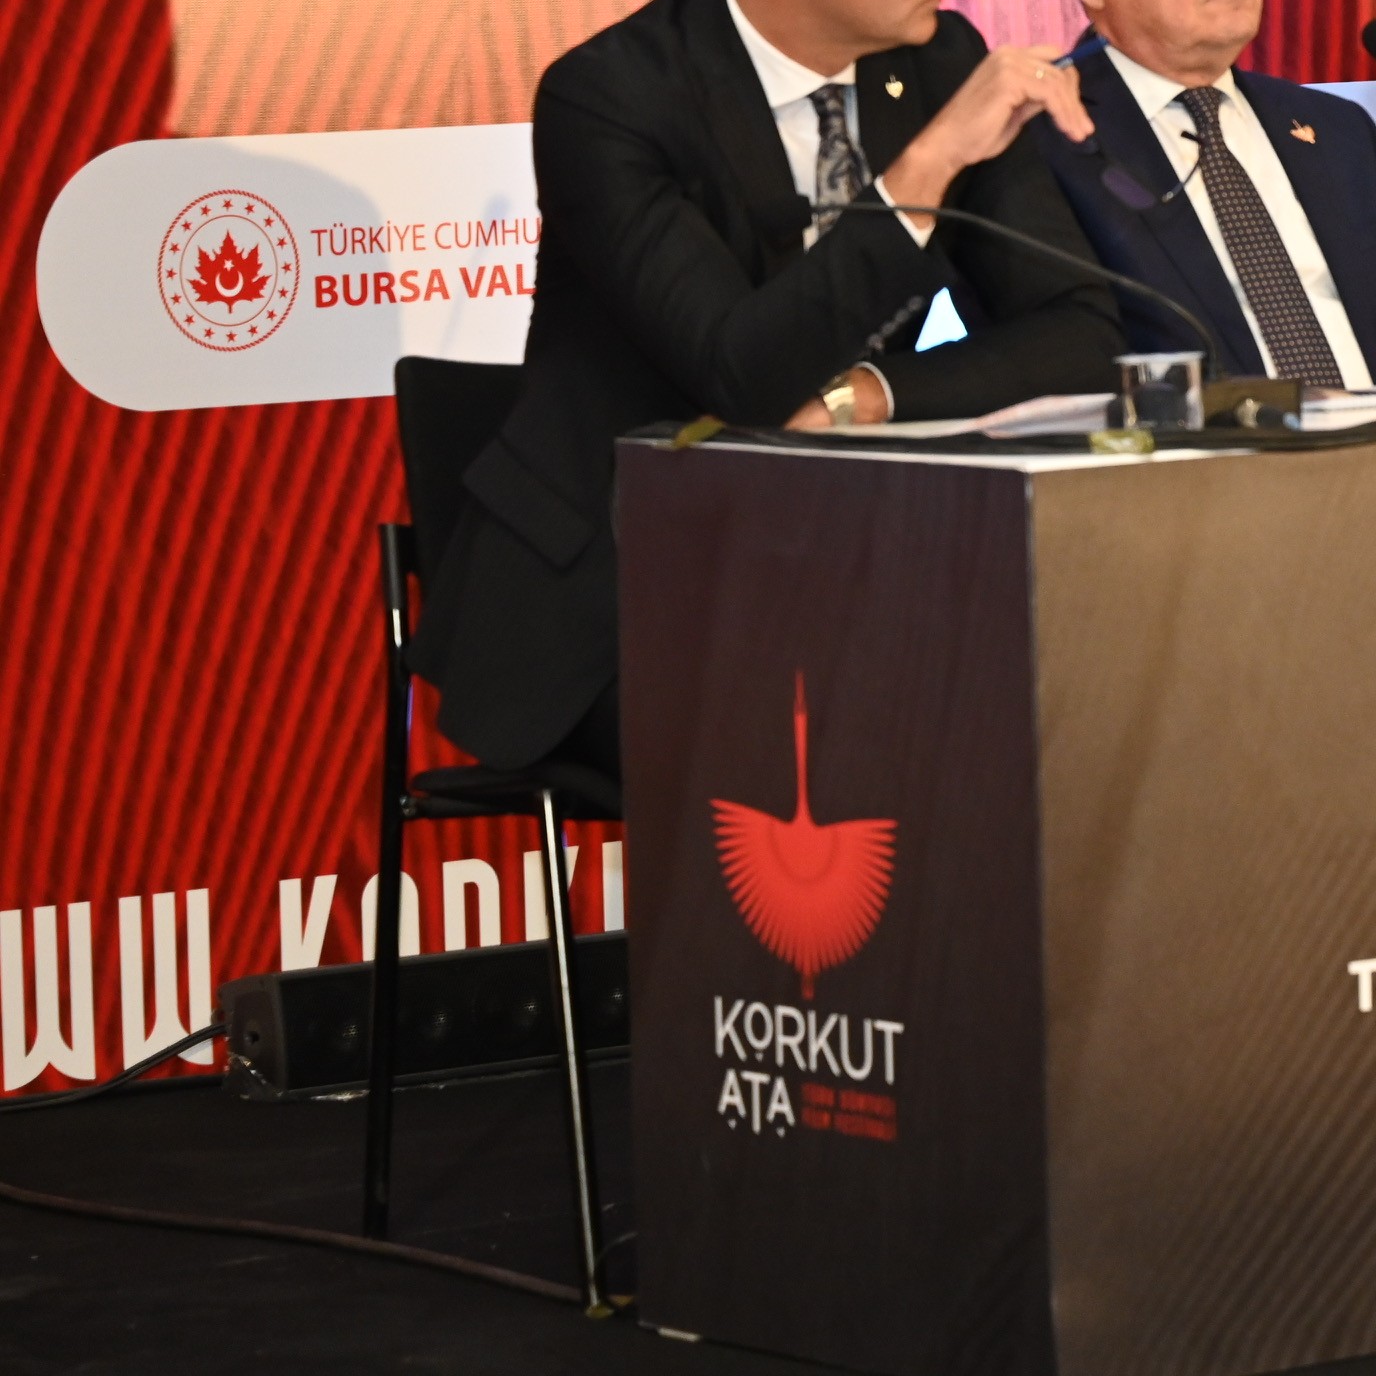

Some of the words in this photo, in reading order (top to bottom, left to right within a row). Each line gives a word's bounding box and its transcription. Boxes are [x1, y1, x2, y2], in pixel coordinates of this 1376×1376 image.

[310, 222, 426, 257] TÜRKİYE
[314, 269, 450, 308] BURSA
[714, 995, 905, 1085] KORKUT
[717, 1068, 796, 1135] ATA
